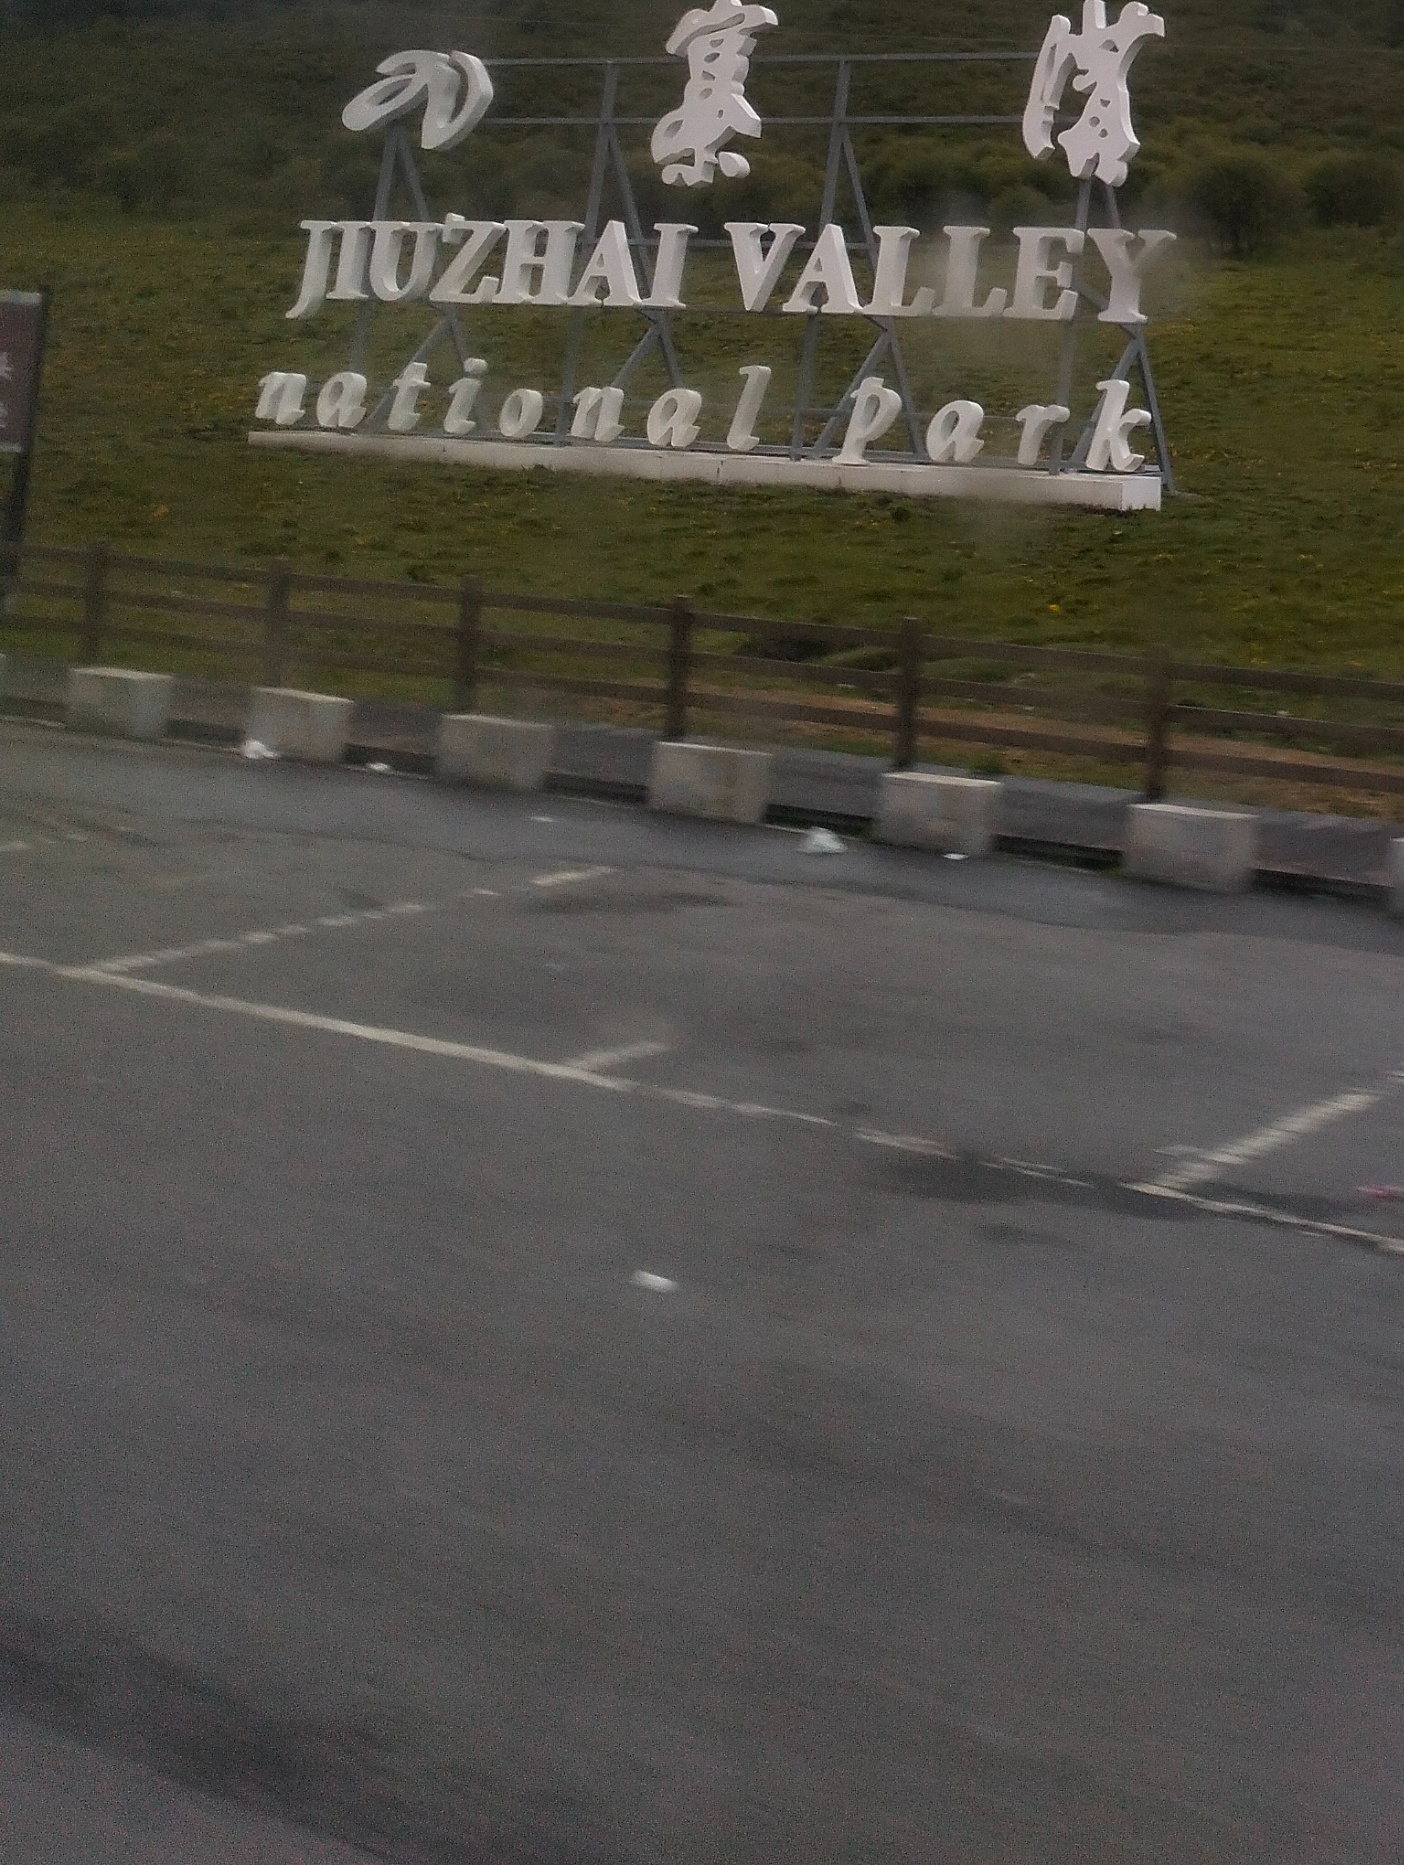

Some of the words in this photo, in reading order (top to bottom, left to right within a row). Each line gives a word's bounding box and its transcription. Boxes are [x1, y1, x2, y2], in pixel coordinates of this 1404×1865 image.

[285, 213, 699, 319] JIUZHAI
[724, 221, 1178, 323] VALLEY
[254, 358, 771, 452] national
[833, 376, 1152, 473] park
